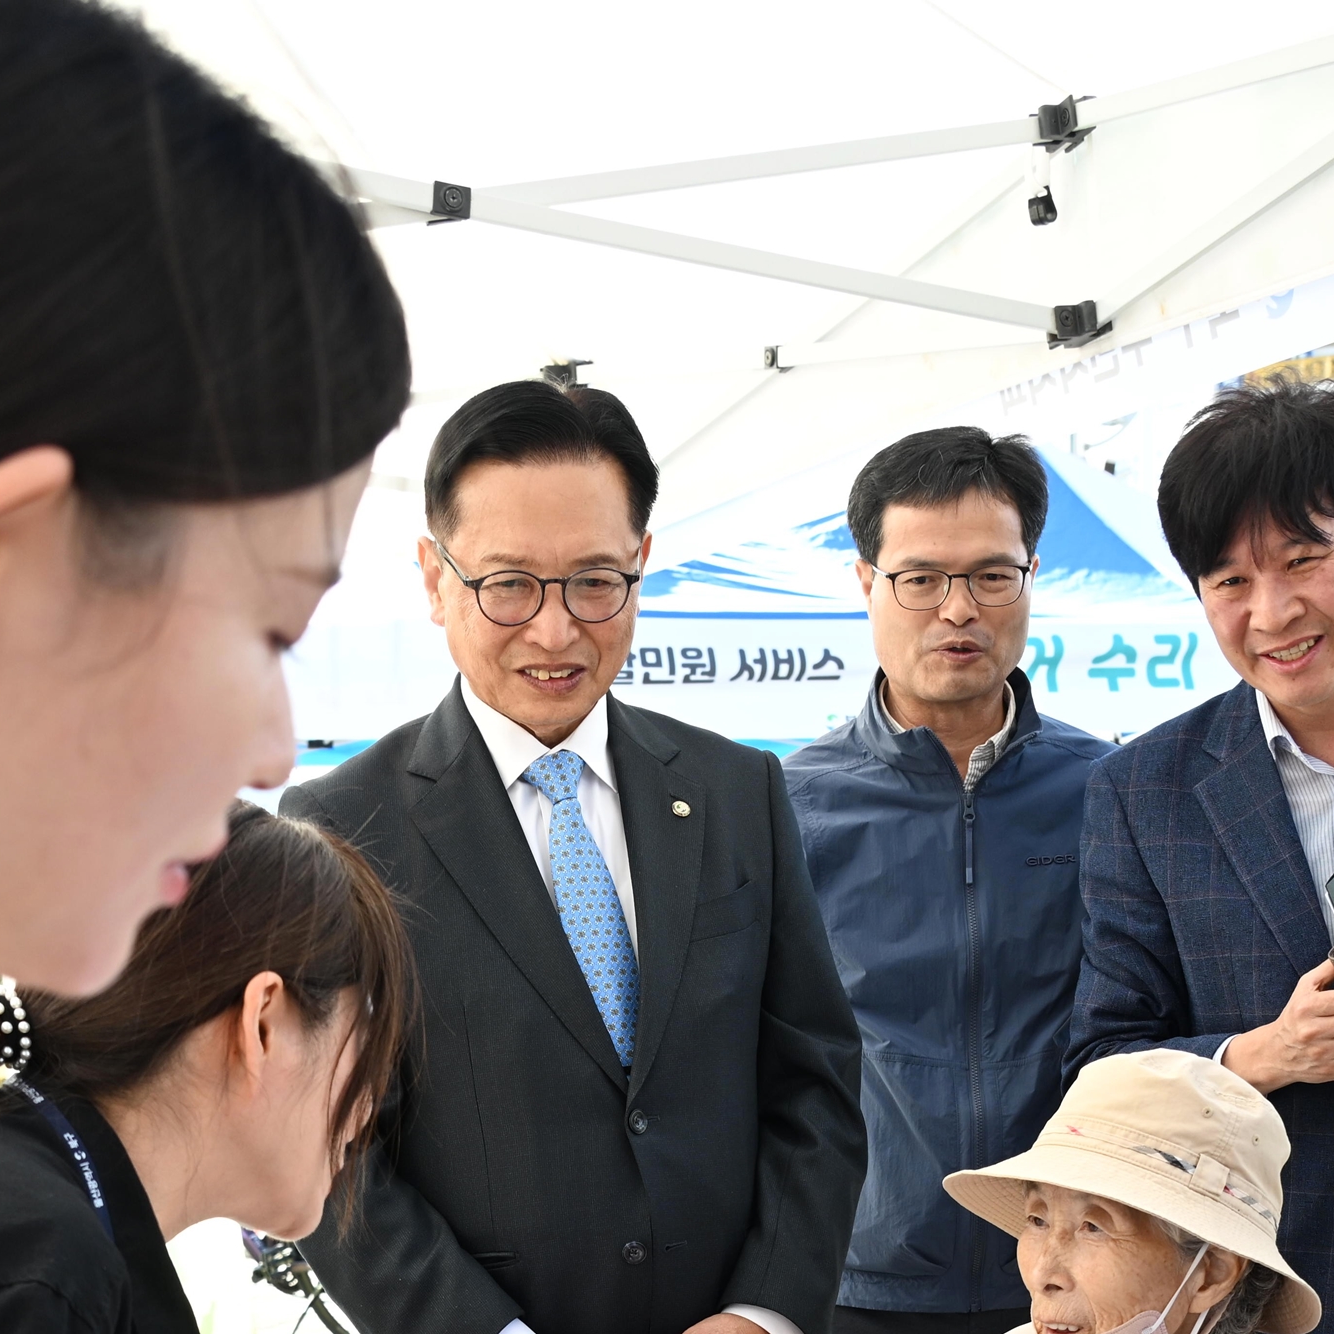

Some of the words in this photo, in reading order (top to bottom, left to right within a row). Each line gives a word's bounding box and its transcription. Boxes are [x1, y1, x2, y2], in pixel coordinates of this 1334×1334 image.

[729, 647, 846, 683] 서비스
[1087, 632, 1199, 692] 수리
[63, 1132, 79, 1149] 북구
[79, 1161, 104, 1208] 울산광역시
